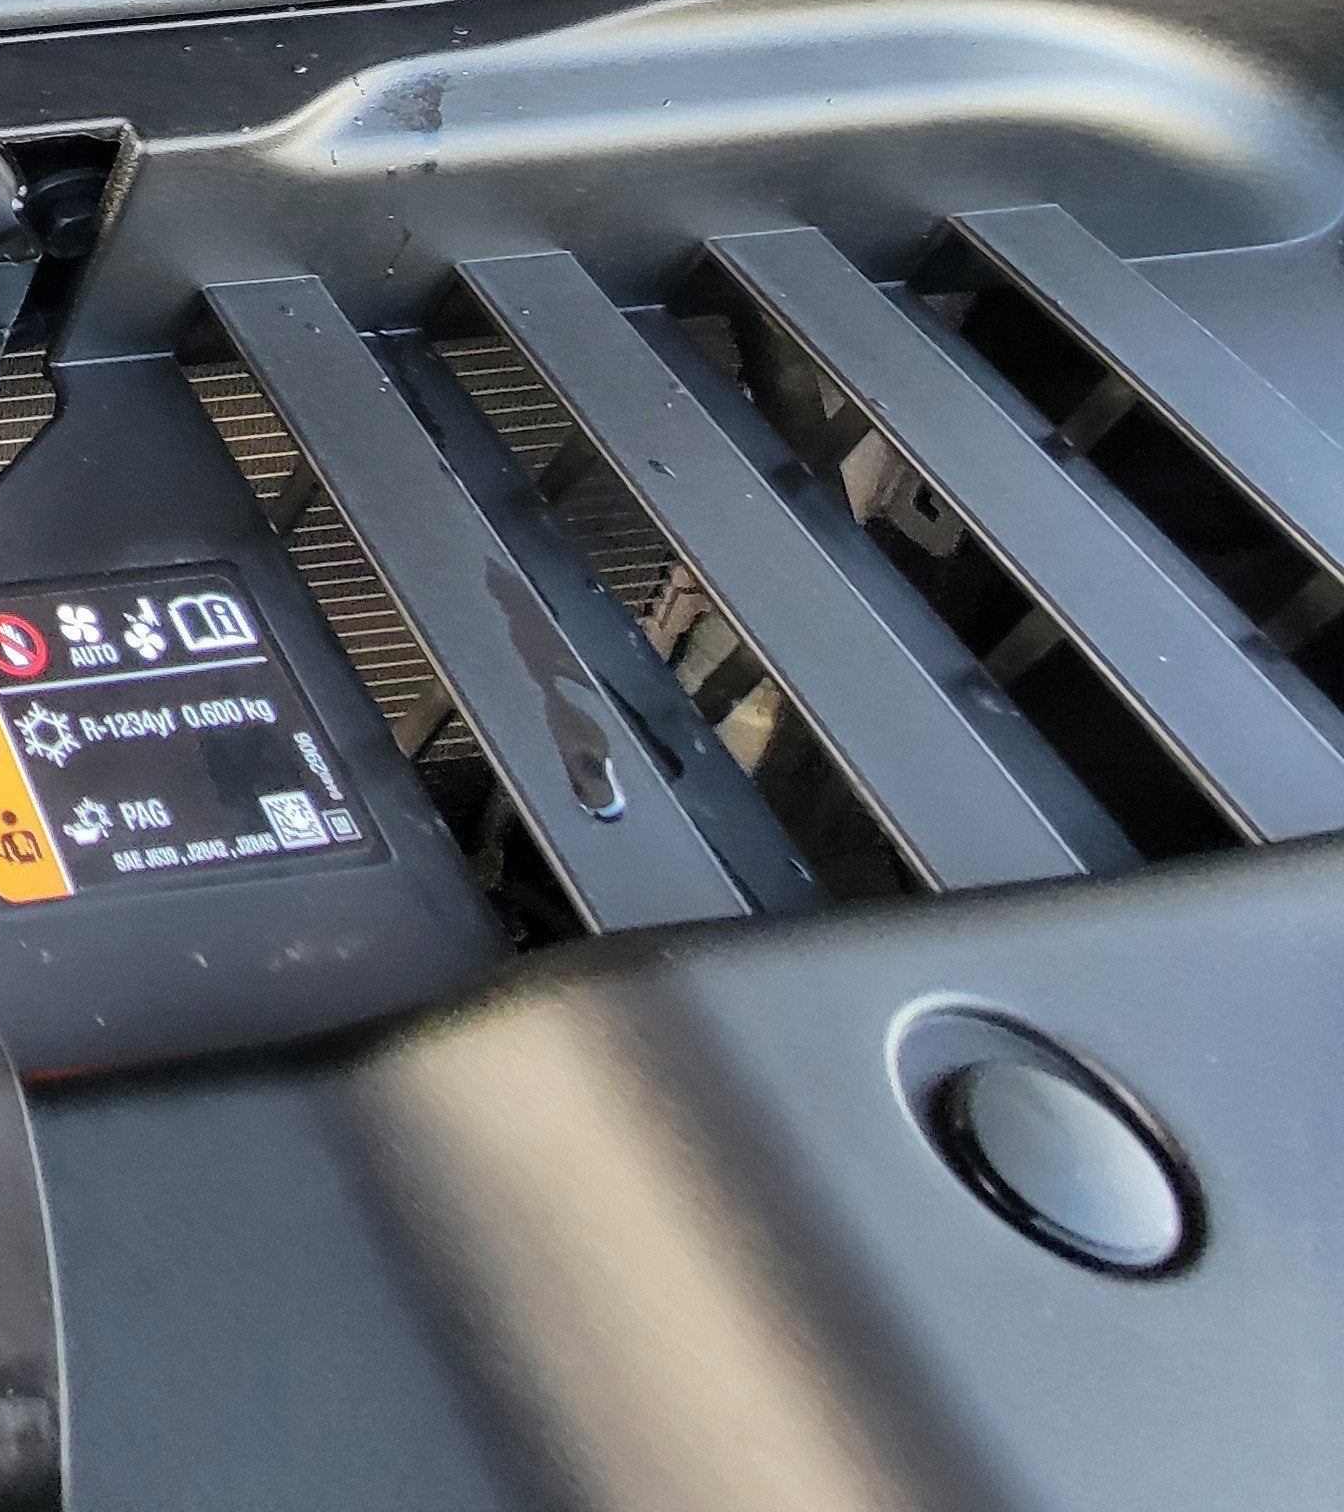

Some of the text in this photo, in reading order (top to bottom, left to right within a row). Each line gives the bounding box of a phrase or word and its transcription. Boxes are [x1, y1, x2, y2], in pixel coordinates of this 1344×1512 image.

[70, 642, 120, 668] AUTO
[79, 696, 277, 740] R-1234yf 0.600 kg
[118, 797, 172, 832] PAG
[112, 849, 146, 874] SAE
